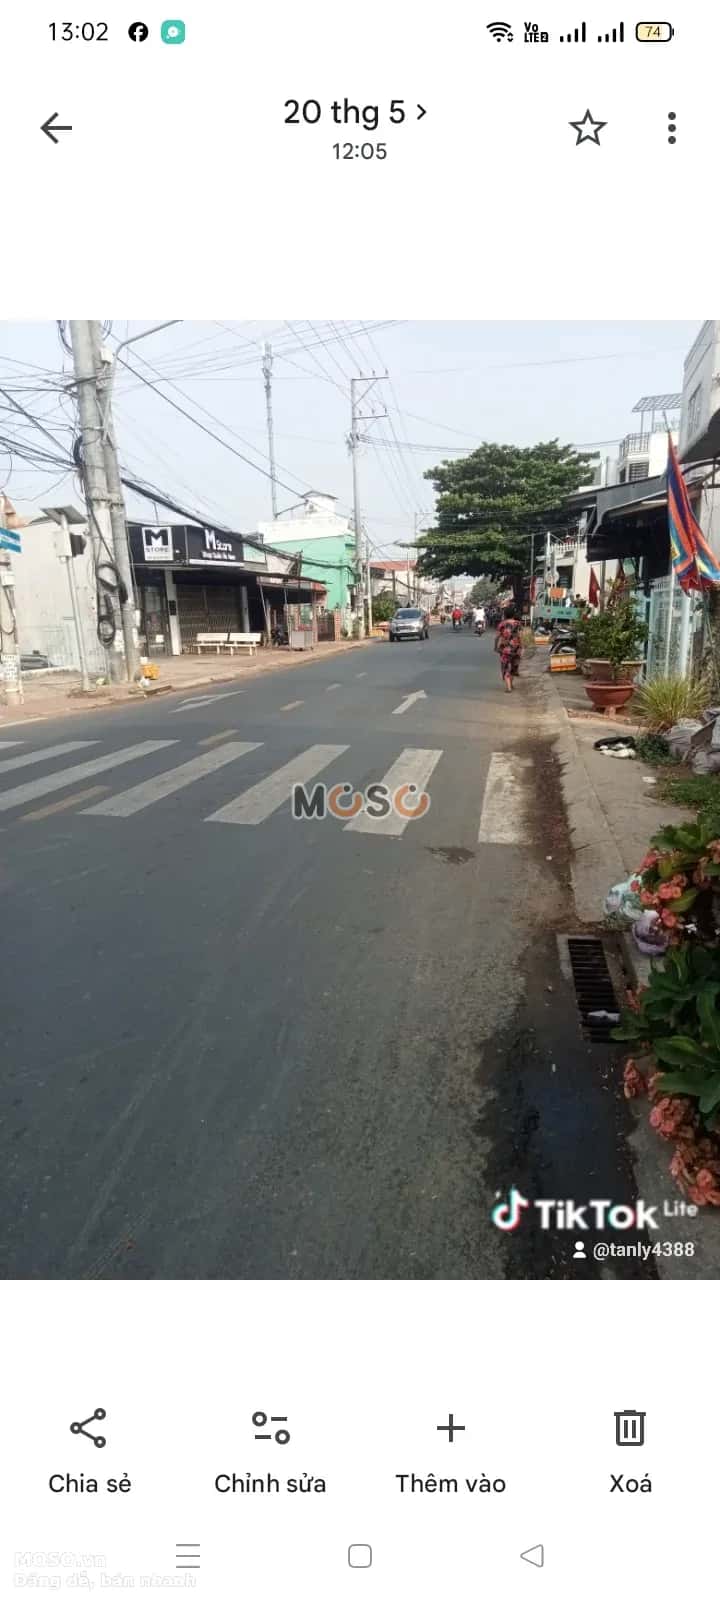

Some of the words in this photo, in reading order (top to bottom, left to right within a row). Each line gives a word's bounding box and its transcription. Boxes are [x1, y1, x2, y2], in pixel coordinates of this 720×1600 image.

[48, 22, 109, 42] 13:02
[646, 26, 661, 37] 74
[284, 99, 322, 124] 20
[330, 98, 379, 131] thg
[389, 99, 406, 124] 5
[332, 142, 387, 160] 12:05
[145, 529, 169, 546] M
[48, 1472, 98, 1493] Chia
[106, 1472, 132, 1493] sẻ
[214, 1472, 280, 1493] Chỉnh
[286, 1472, 326, 1493] sửa
[395, 1472, 458, 1493] Thêm
[465, 1472, 506, 1493] vào
[609, 1472, 652, 1493] Xoá
